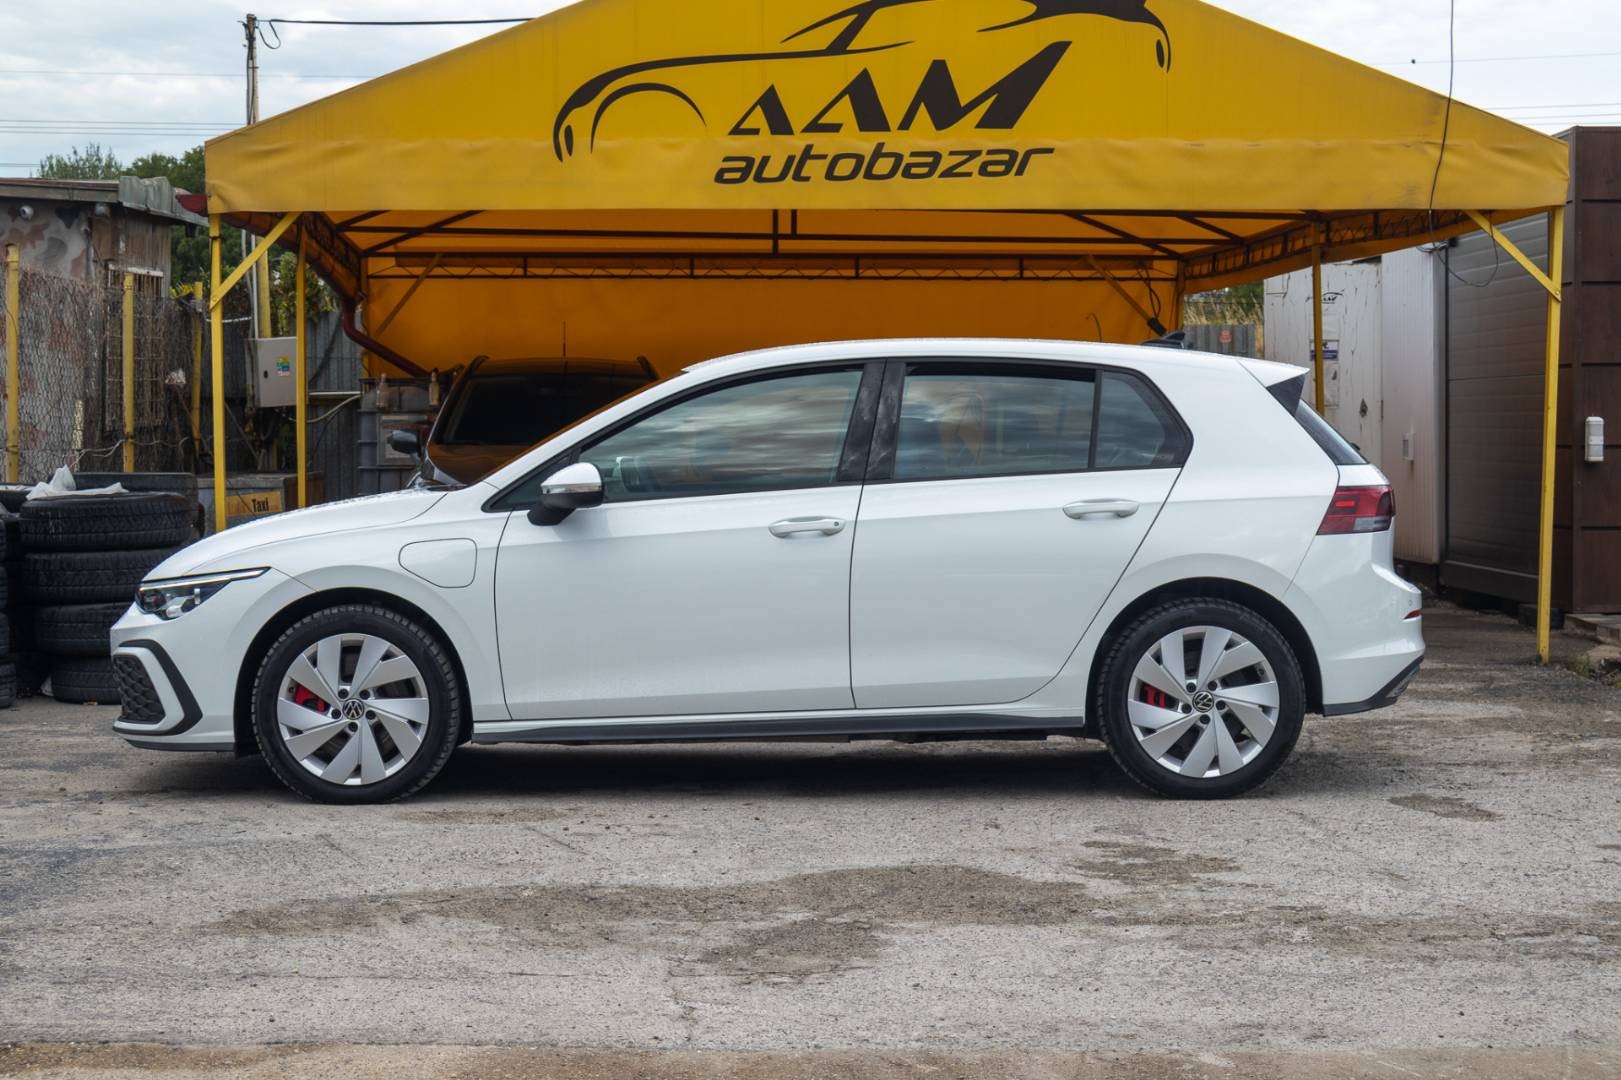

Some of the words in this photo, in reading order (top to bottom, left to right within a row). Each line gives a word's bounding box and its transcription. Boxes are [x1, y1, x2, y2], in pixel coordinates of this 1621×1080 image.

[727, 41, 1073, 136] AAM
[714, 142, 1055, 185] autobazar
[251, 497, 269, 513] Taxi
